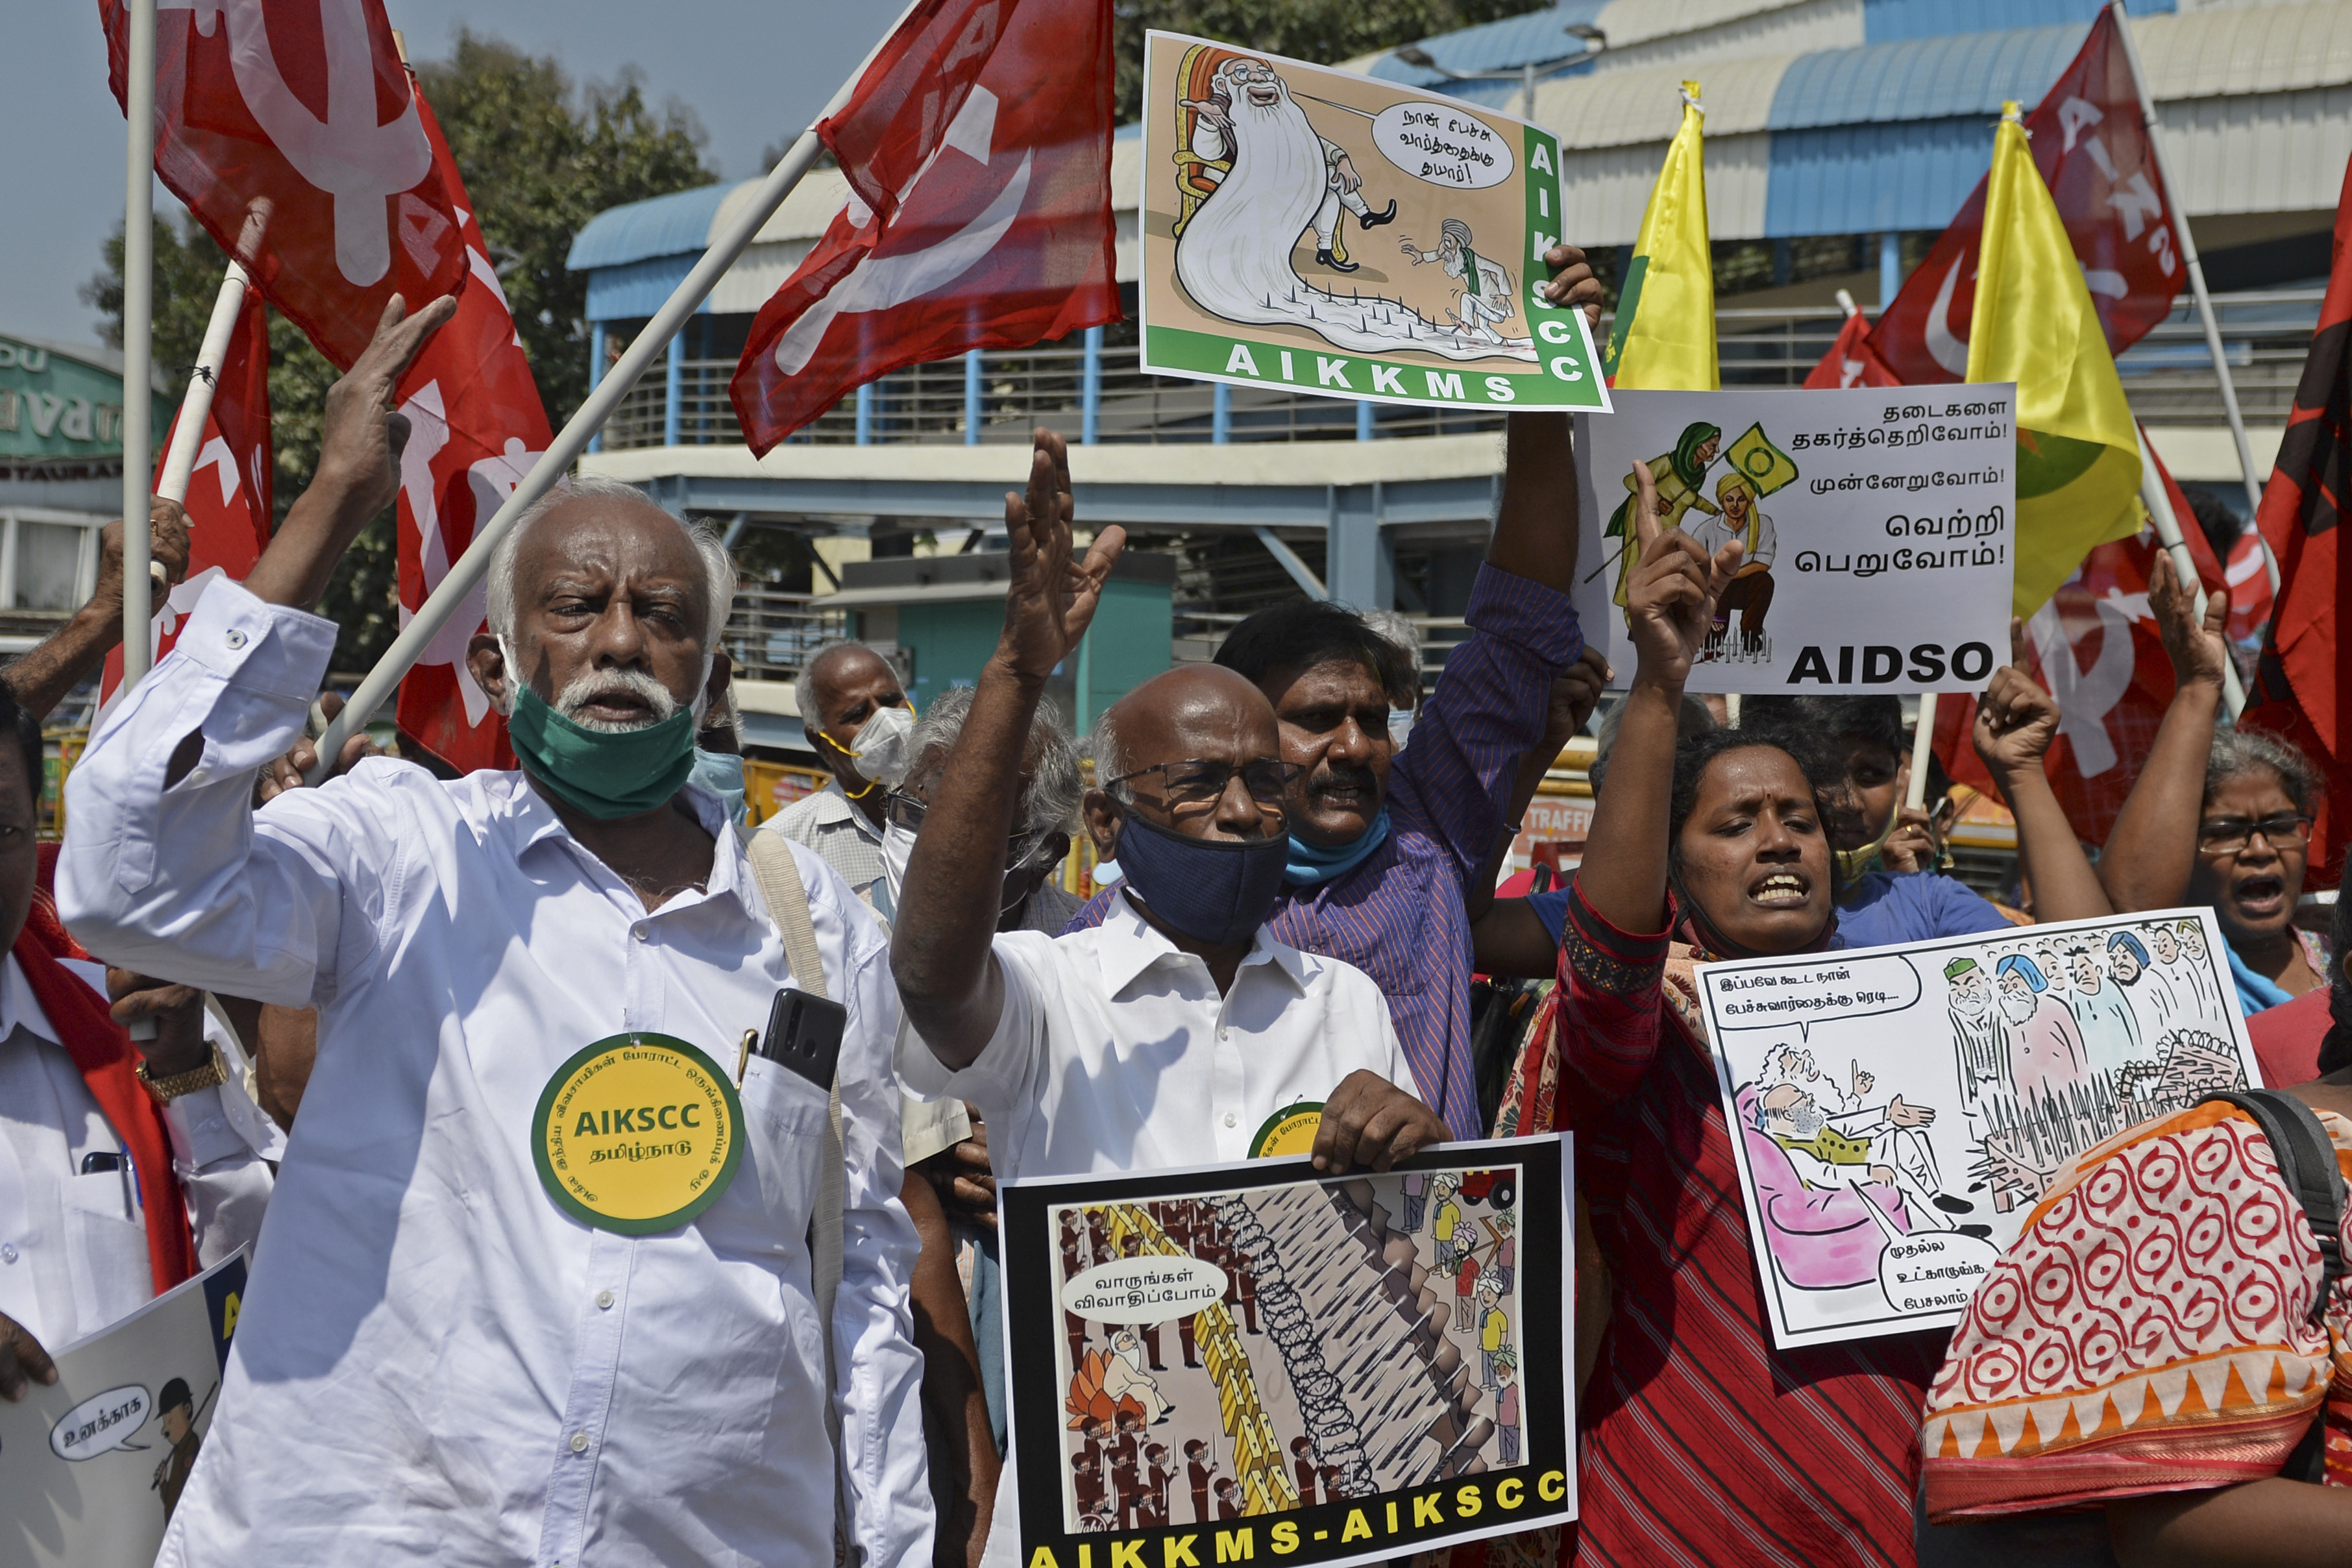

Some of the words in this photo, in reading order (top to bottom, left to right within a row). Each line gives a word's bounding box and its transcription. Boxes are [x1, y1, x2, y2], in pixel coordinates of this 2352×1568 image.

[1402, 110, 1439, 129] நான்
[1449, 119, 1491, 141] பேச்சு
[1400, 133, 1494, 167] வார்த்தைக்கு
[1419, 162, 1473, 184] தயார்!
[1225, 344, 1515, 402] AIKKMS
[1883, 401, 2007, 424] தடைகளை
[1792, 421, 2007, 451] தகர்த்தெறிவோம்!
[1810, 466, 2004, 495] முன்னேறுவோம்!
[1885, 505, 2004, 540] வெற்றி
[1795, 541, 2004, 578] பெறுவோம்!
[1786, 641, 1993, 684] AIDSO
[1720, 975, 1777, 992] இப்பவே
[1780, 974, 1813, 986] கூட
[1817, 966, 1850, 983] நான்
[556, 1056, 616, 1119] விவசாயிகள்
[622, 1051, 681, 1070] போராட்ட
[574, 1103, 700, 1137] AIKSCC
[589, 1140, 692, 1165] தமிழ்நாடு
[1890, 1239, 1945, 1258] முதல்ல
[1096, 1268, 1194, 1290] வாருங்கள்
[1075, 1284, 1216, 1310] விவாதிப்போம்
[1904, 1288, 1968, 1310] பேசலாம்
[63, 1397, 141, 1449] உனக்காக
